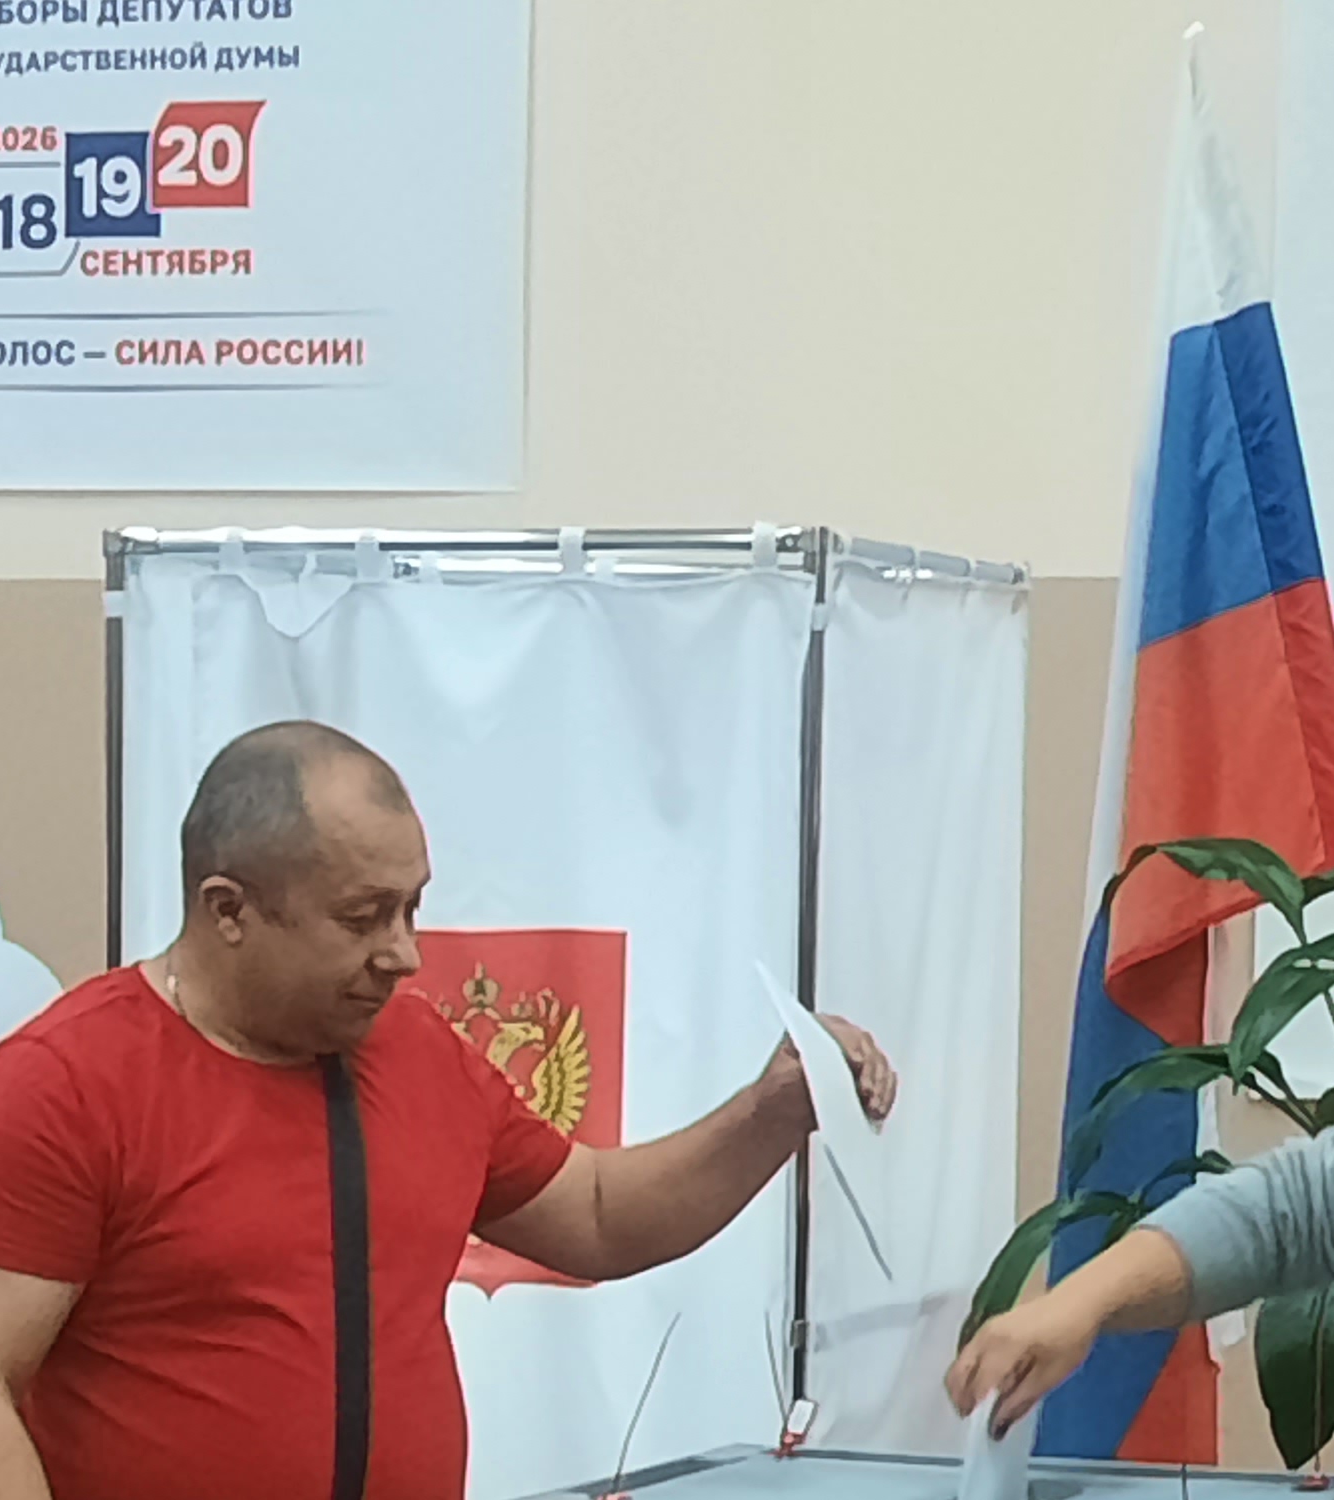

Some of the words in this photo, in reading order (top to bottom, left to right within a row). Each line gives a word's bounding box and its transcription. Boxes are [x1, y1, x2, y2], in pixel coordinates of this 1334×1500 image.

[97, 0, 293, 27] ДЕПУТАТОВ
[214, 46, 300, 71] ДУМЫ
[73, 156, 142, 218] 19
[157, 124, 244, 187] 20
[79, 250, 252, 276] СЕНТЯБРЯ
[114, 339, 206, 367] СИЛА
[215, 338, 364, 367] РОССИИ!
